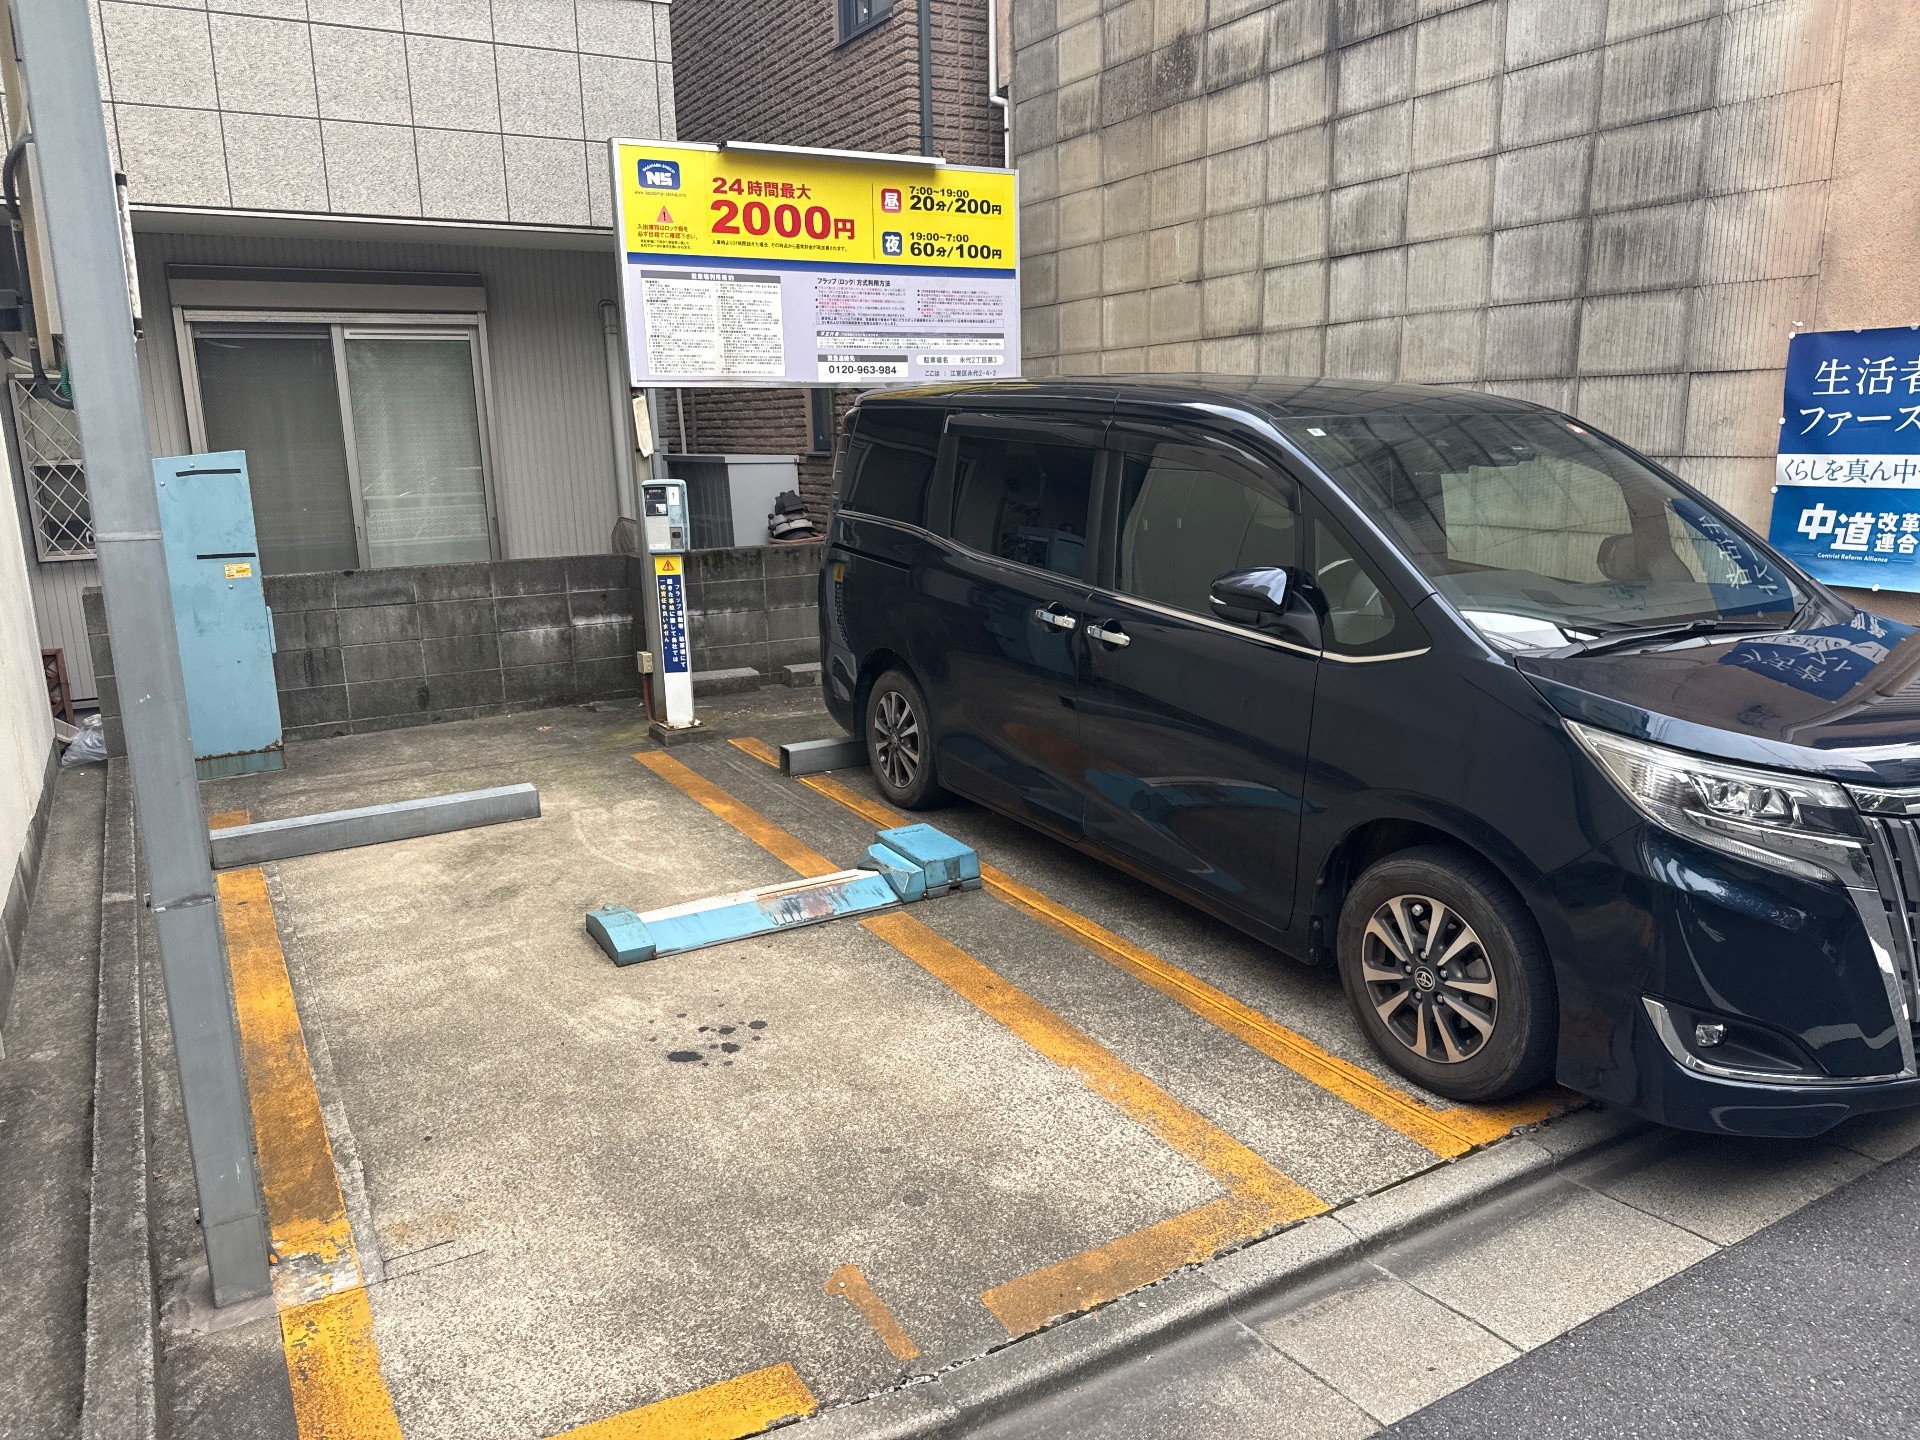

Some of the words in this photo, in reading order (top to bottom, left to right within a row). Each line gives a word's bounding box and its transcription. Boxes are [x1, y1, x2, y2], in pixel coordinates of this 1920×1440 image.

[712, 177, 811, 200] 24時間最大
[884, 192, 899, 210] 昼
[910, 195, 1002, 215] 20分/200円
[710, 199, 855, 240] 2000円
[885, 235, 900, 253] 夜
[910, 242, 1002, 259] 60分/100円
[828, 365, 897, 375] 0120-963-984
[1784, 458, 1920, 484] くらしを真ん中
[1797, 503, 1876, 552] 中道
[1878, 512, 1920, 533] 改革
[1874, 532, 1919, 554] 連合
[1817, 552, 1840, 560] Centrist
[1841, 553, 1863, 561] Reform
[1863, 555, 1888, 563] Alliance
